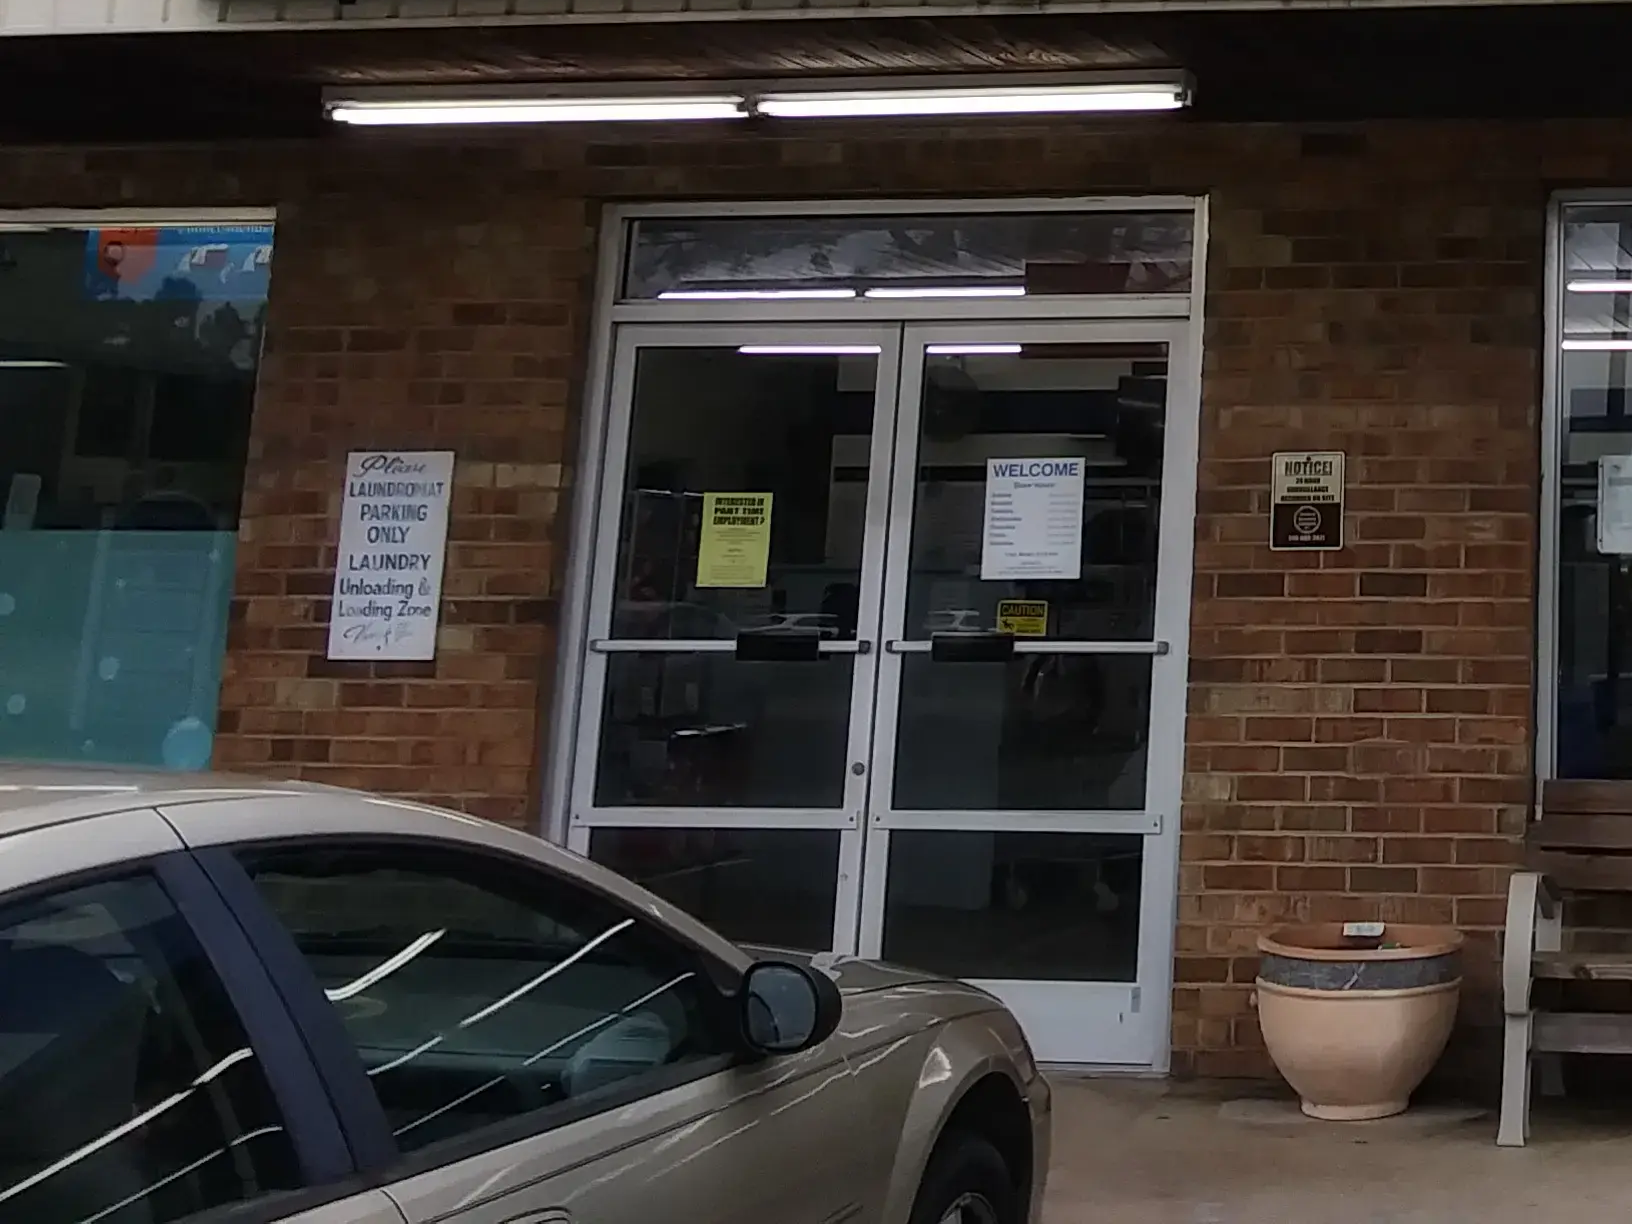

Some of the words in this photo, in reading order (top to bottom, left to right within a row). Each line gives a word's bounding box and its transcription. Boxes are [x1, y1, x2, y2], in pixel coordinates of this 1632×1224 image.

[993, 462, 1079, 477] WELCOME
[1284, 460, 1333, 476] NOTICE!
[349, 481, 445, 498] LAUNDROMAT
[360, 503, 429, 522] PARKING
[367, 526, 411, 544] ONLY
[349, 553, 432, 571] LAUNDRY
[339, 577, 415, 600] Unloading
[418, 577, 431, 596] &
[338, 600, 393, 622] Loading
[396, 600, 433, 618] Zone
[1002, 604, 1044, 617] CAUTION
